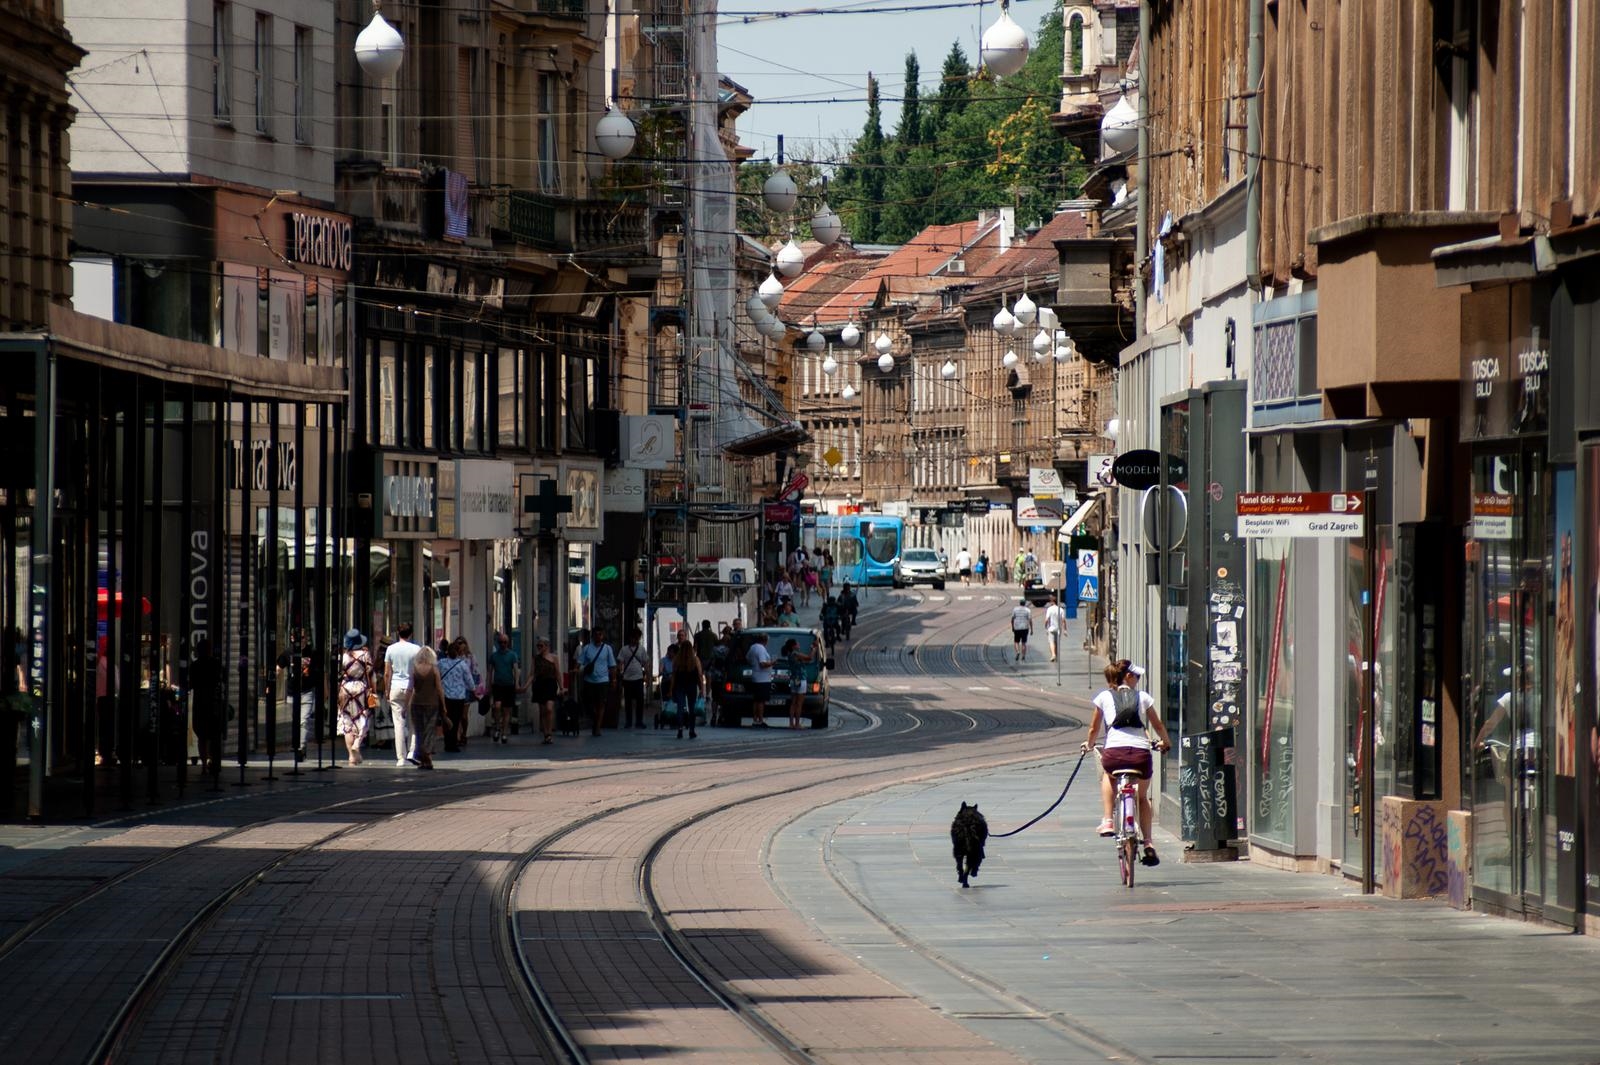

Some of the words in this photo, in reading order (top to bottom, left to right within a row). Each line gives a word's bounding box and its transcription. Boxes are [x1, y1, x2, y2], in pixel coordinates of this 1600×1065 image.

[1472, 357, 1500, 380] TOSCA
[1518, 350, 1548, 373] TOSCA
[1476, 380, 1493, 398] BLU
[1524, 374, 1541, 392] BLU
[1239, 495, 1259, 505] Tunel
[1260, 494, 1276, 505] Grič
[1281, 495, 1297, 504] ulaz
[1297, 495, 1303, 504] 4
[1240, 504, 1259, 512] Tunnel
[1245, 518, 1274, 527] Besplatni
[1308, 522, 1328, 531] Grad
[1330, 522, 1359, 532] Zagreb
